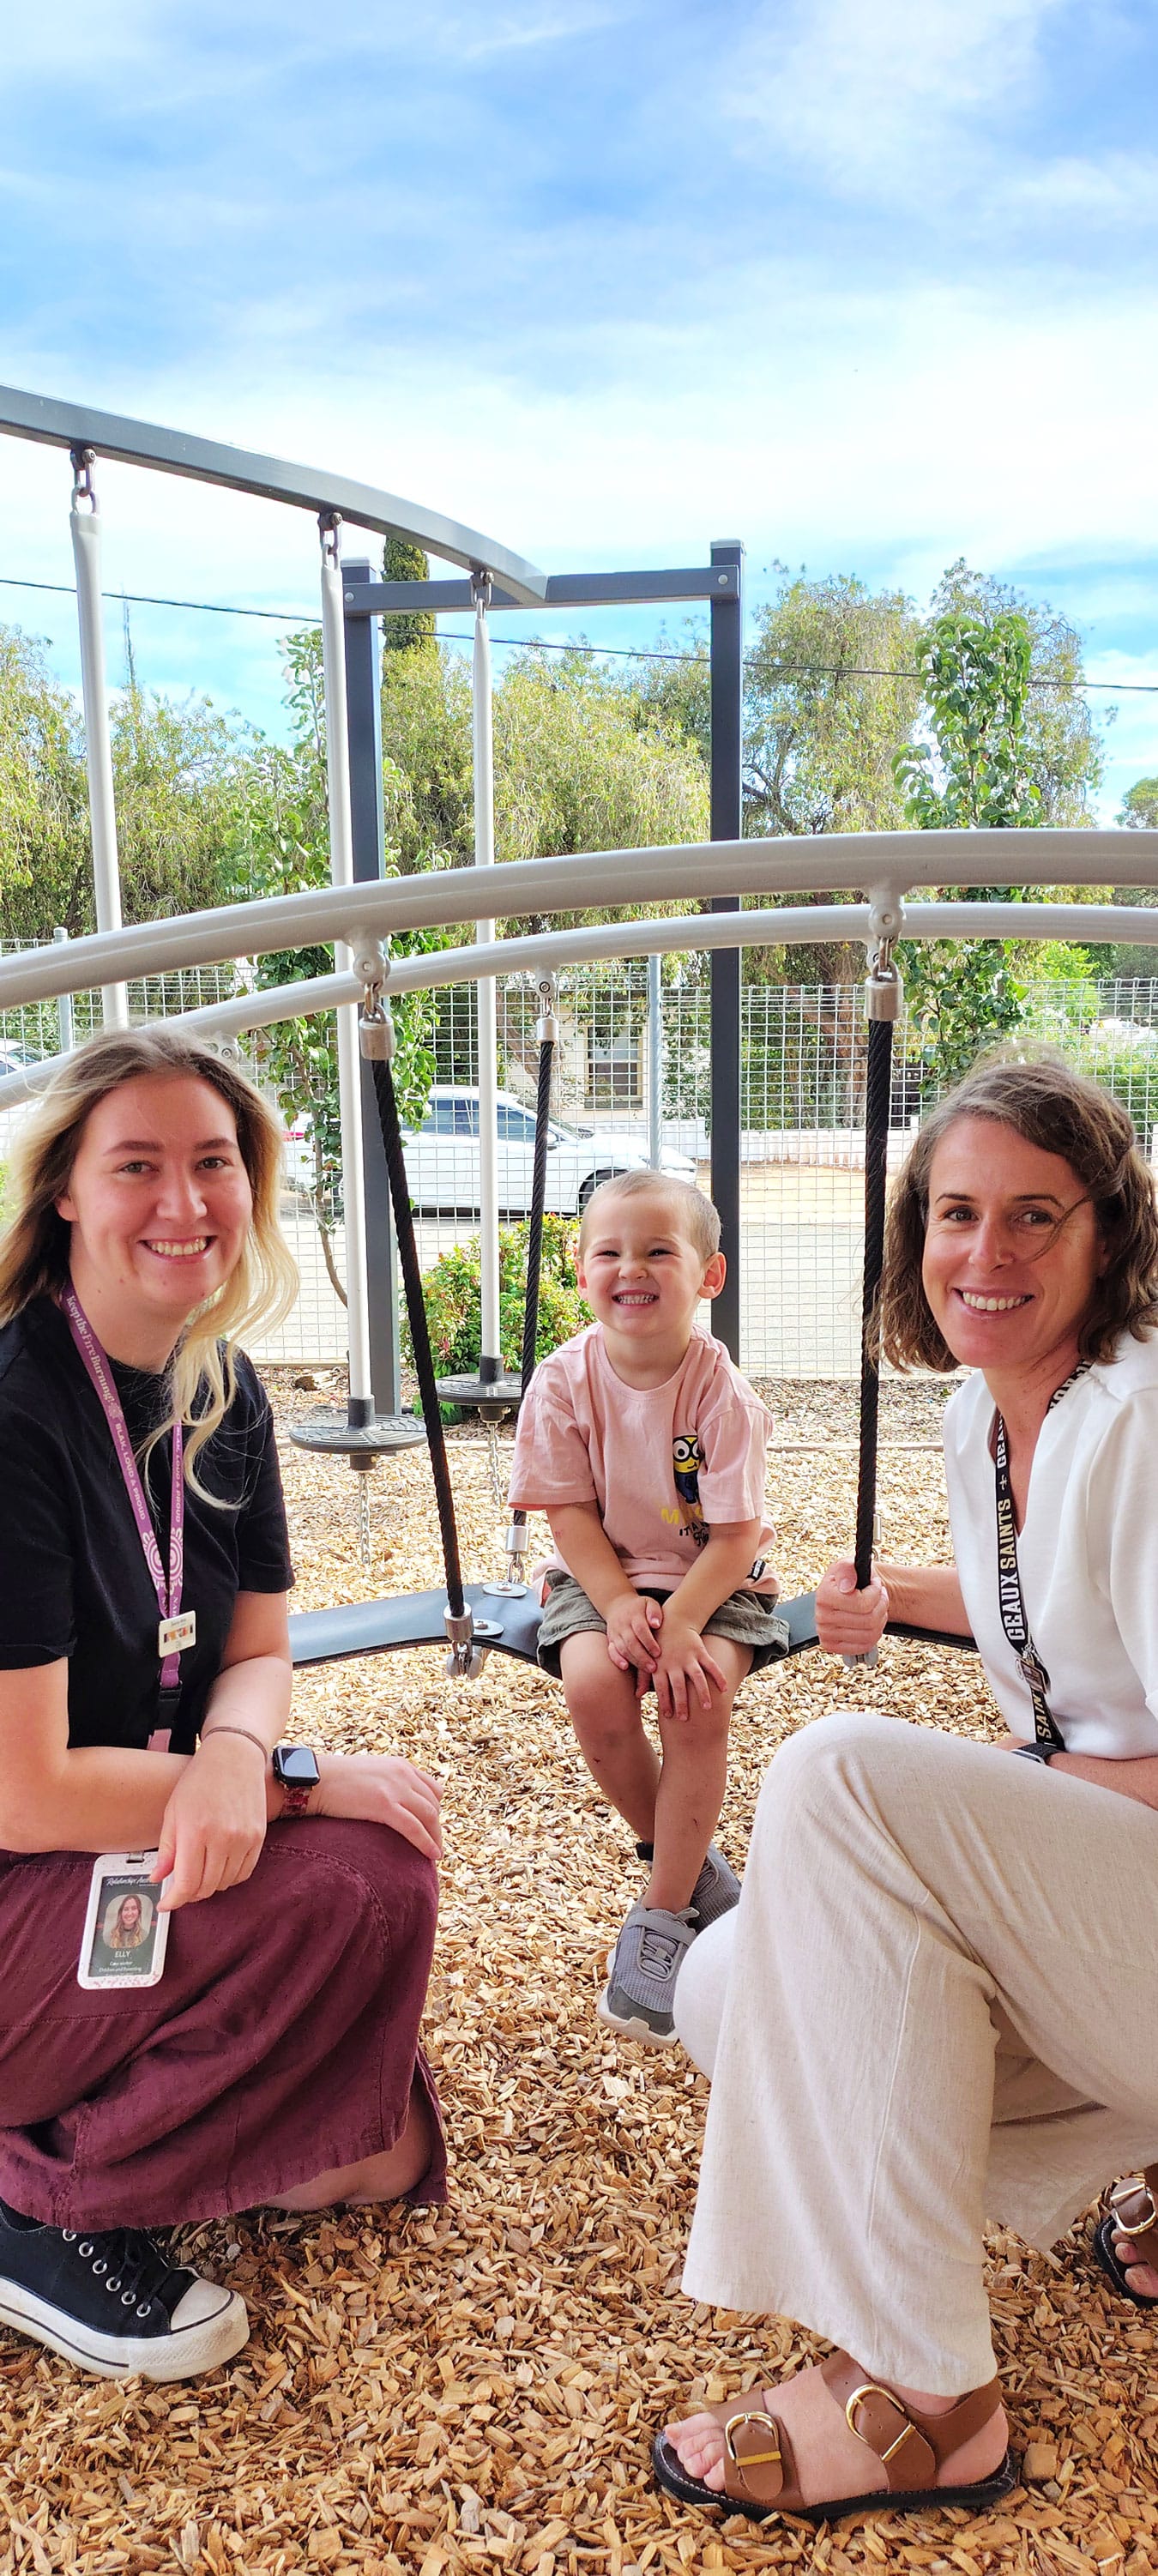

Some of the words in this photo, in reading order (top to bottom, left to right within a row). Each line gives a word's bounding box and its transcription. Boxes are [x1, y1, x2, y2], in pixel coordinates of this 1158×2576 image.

[67, 1295, 81, 1318] Keep
[75, 1318, 87, 1335] the
[82, 1333, 97, 1356] Fire
[123, 1451, 135, 1477] LOUD
[133, 1487, 147, 1520] PROUD
[998, 1498, 1016, 1570] SAINTS
[1000, 1571, 1027, 1641] GEAUX
[1032, 1689, 1052, 1740] SAIN
